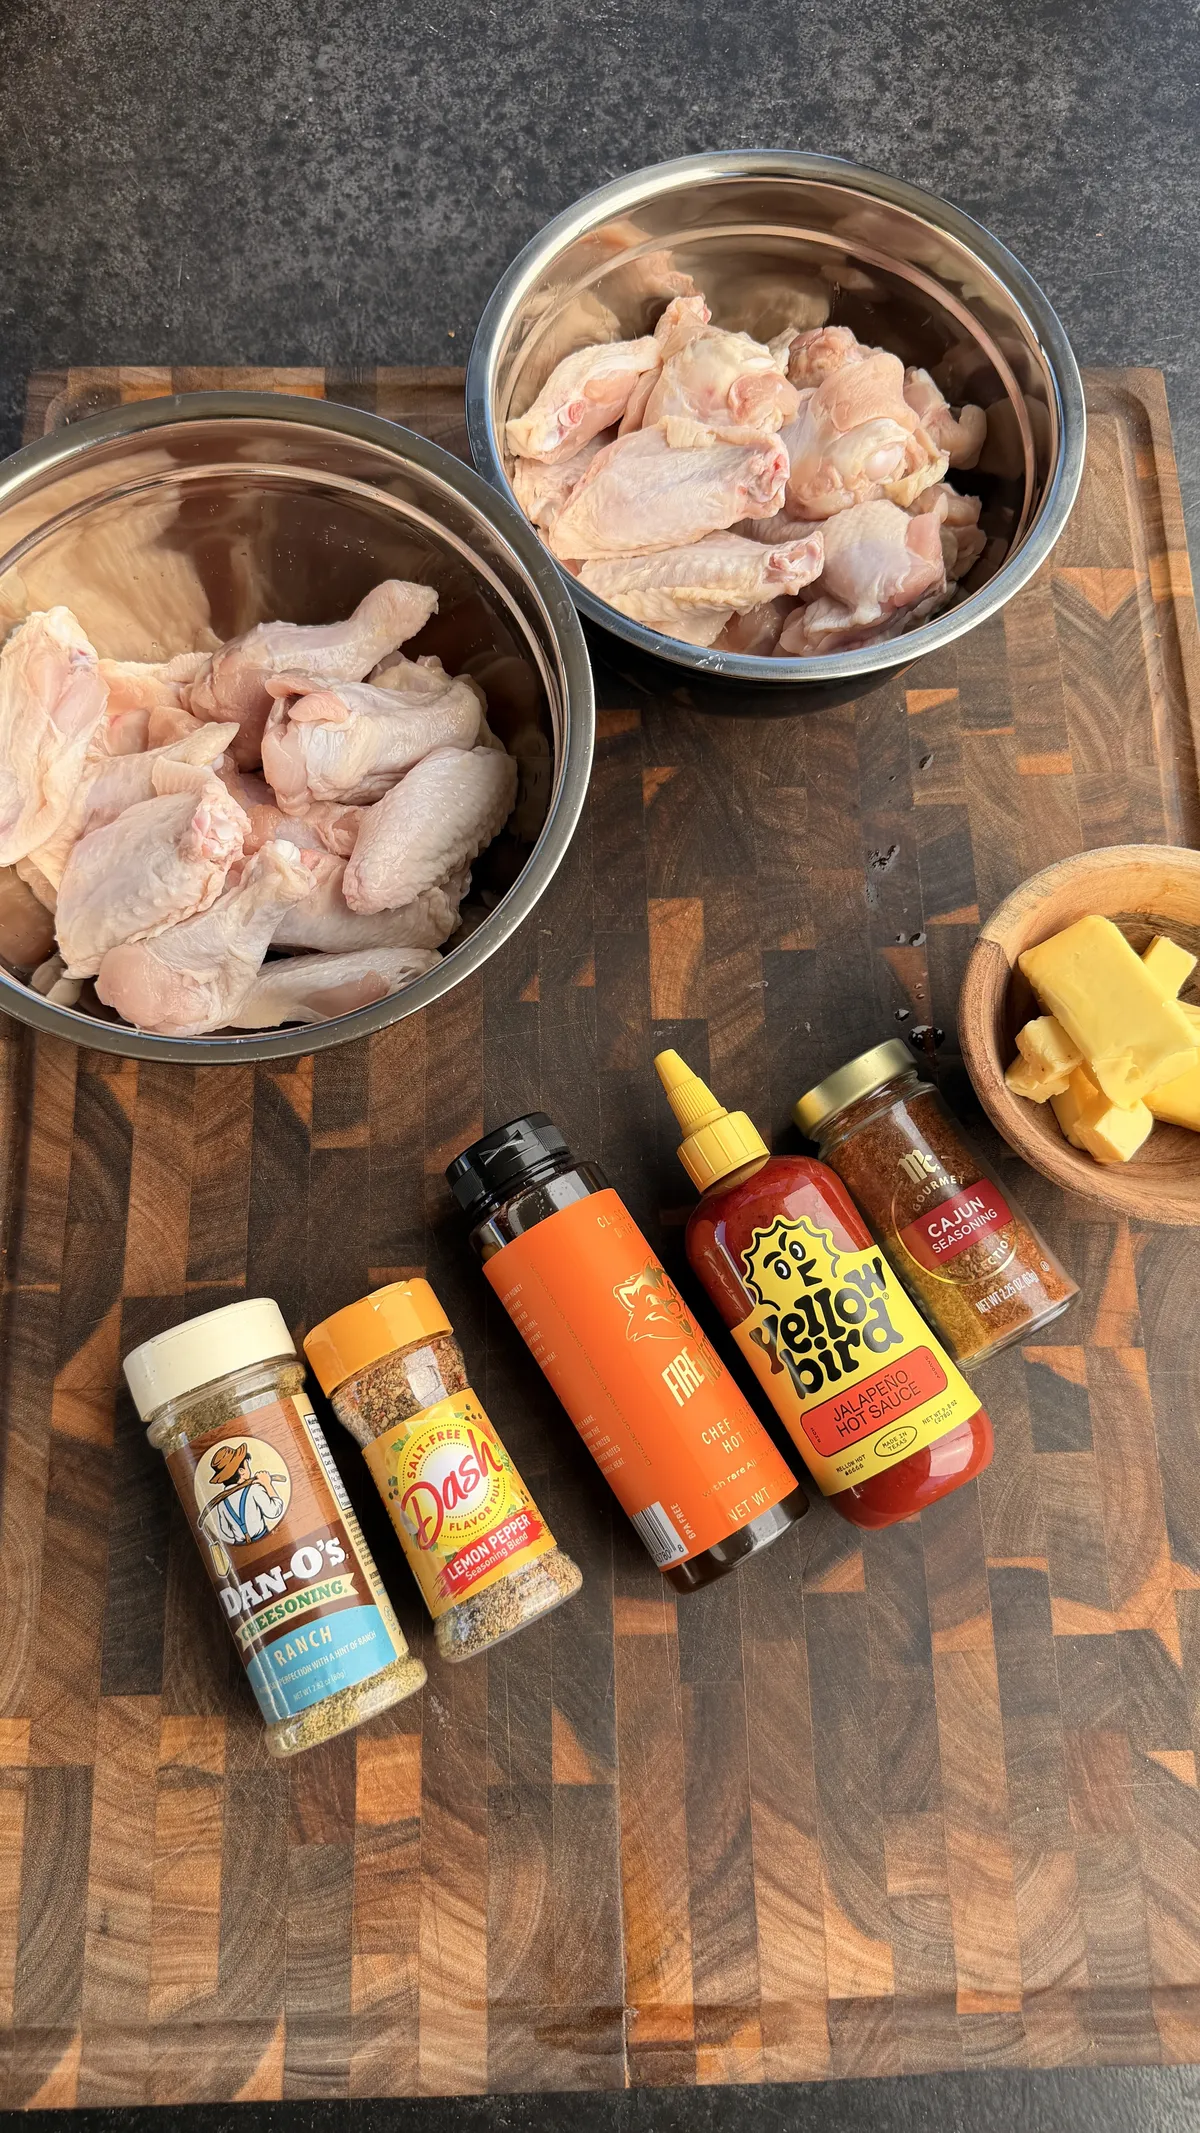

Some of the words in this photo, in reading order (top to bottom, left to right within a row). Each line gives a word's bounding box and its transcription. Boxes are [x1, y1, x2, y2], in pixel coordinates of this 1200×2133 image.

[912, 1171, 964, 1212] GOURMET
[927, 1196, 985, 1238] CAJUN
[931, 1208, 998, 1254] SEASONING
[975, 1297, 992, 1314] NET
[986, 1291, 1003, 1307] WT
[998, 1282, 1017, 1301] 2.25
[1012, 1276, 1026, 1292] OZ
[779, 1297, 904, 1400] bird
[924, 1355, 941, 1379] SAVORY
[833, 1369, 909, 1423] JALAPEÑO
[836, 1411, 869, 1439] HOT
[864, 1380, 922, 1420] SAUCE
[921, 1414, 934, 1425] NET
[407, 1429, 461, 1479] SALT-FREE
[721, 1431, 745, 1454] HOT
[881, 1436, 898, 1449] MADE
[898, 1431, 908, 1441] IN
[887, 1437, 908, 1452] TEXAS
[726, 1466, 746, 1483] rare
[835, 1459, 855, 1474] MELLOW
[854, 1453, 867, 1465] HOT
[401, 1428, 503, 1550] Dash
[449, 1503, 493, 1532] FLAVOR
[490, 1476, 500, 1505] FULL
[727, 1499, 751, 1522] NET
[751, 1486, 771, 1507] WT
[670, 1502, 687, 1524] FREE
[683, 1522, 697, 1540] BPA
[446, 1542, 490, 1581] LEMON
[490, 1513, 531, 1550] PEPPER
[465, 1548, 509, 1582] Seasoning
[507, 1532, 529, 1553] Blend
[273, 1625, 333, 1667] RANCH
[311, 1655, 330, 1670] WITH
[329, 1652, 336, 1661] A
[334, 1645, 350, 1658] HINT
[349, 1641, 357, 1650] OF
[357, 1630, 377, 1647] RANCH
